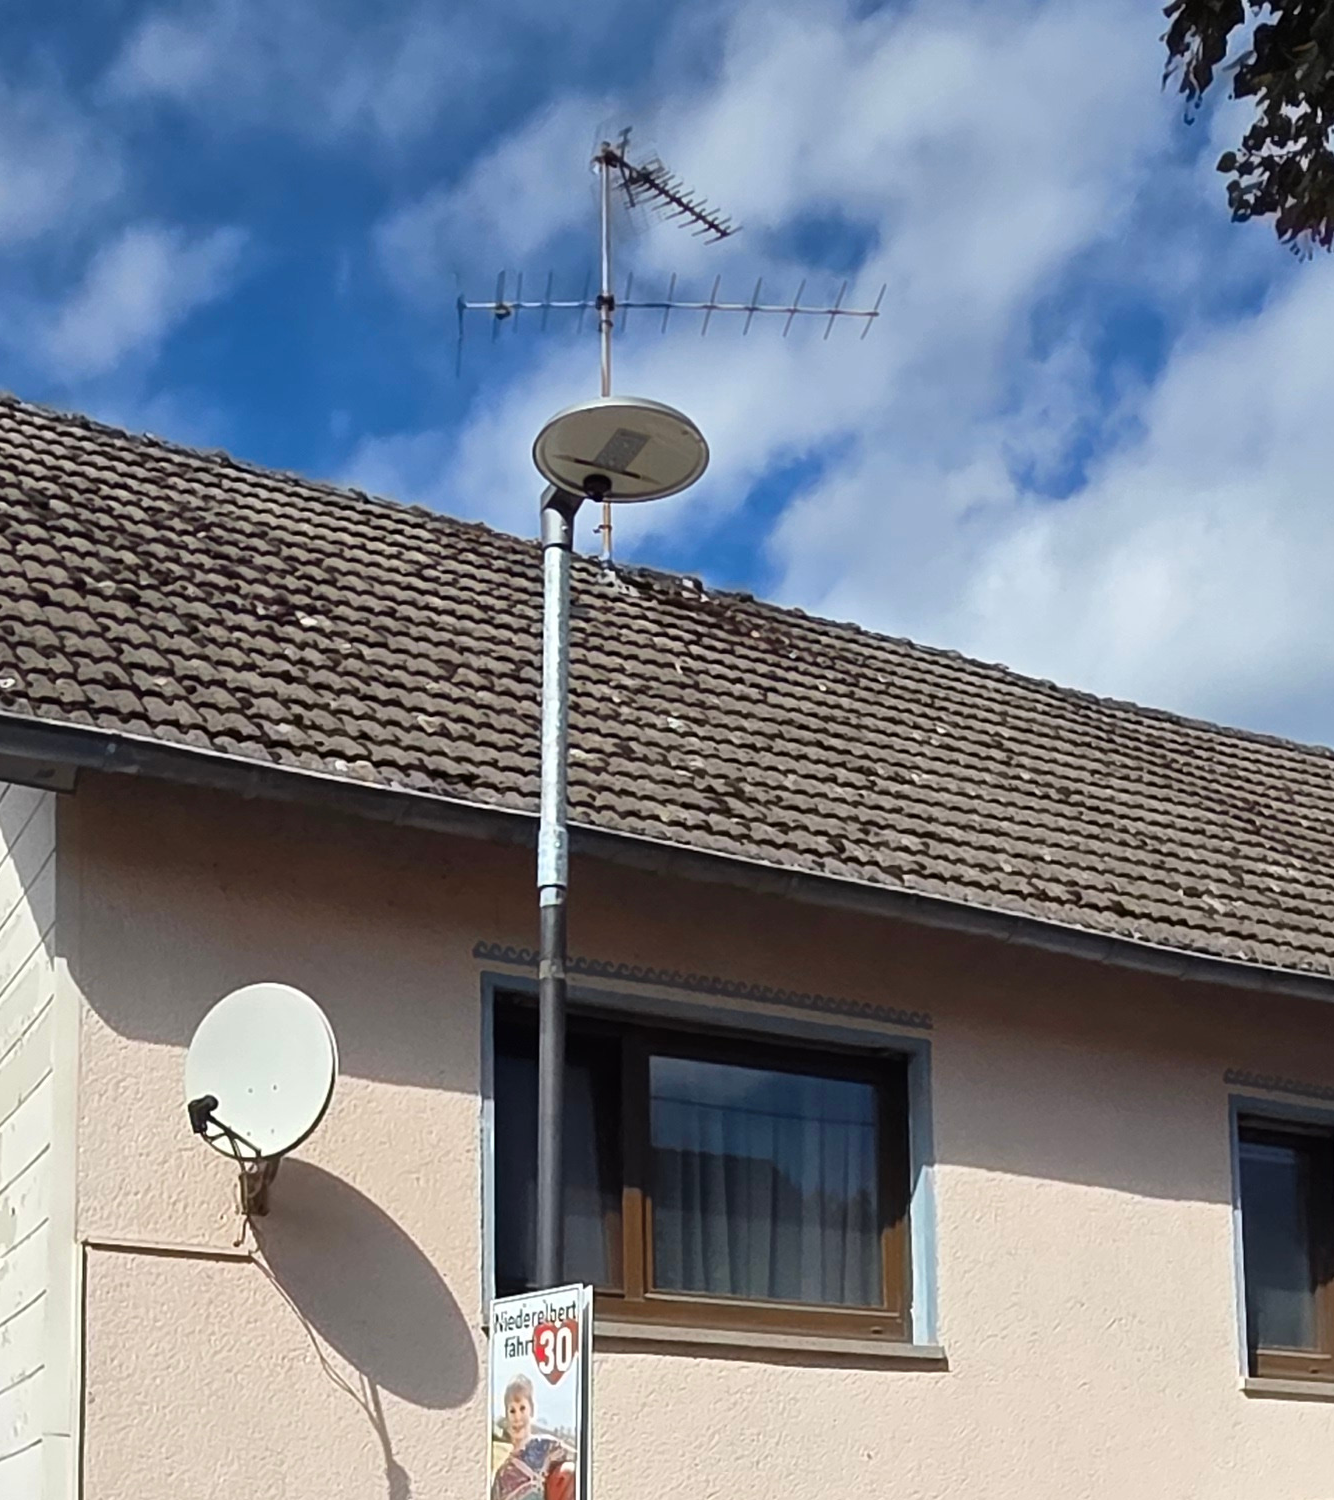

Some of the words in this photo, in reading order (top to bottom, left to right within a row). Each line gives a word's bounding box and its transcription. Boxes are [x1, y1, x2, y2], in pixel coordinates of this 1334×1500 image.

[494, 1300, 576, 1334] Niederelbert
[504, 1335, 534, 1359] fähr
[539, 1327, 572, 1375] 30
